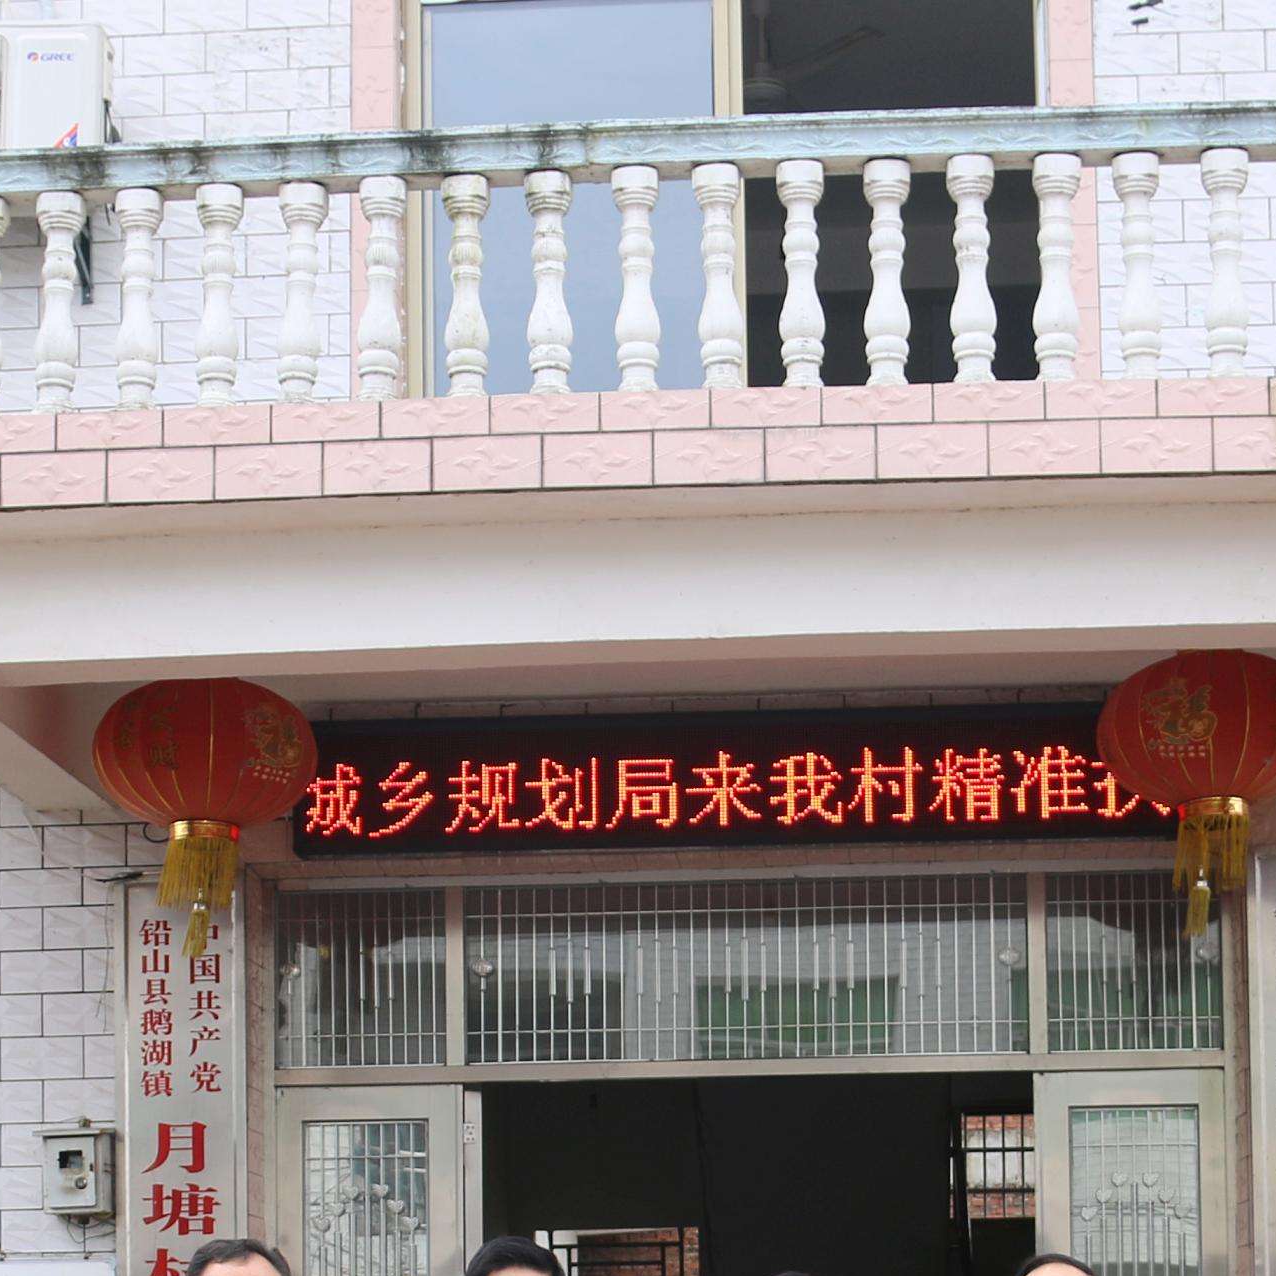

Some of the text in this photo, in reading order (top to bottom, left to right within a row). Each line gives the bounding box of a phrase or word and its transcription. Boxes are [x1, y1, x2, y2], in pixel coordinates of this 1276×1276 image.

[139, 919, 172, 1097] 铅山县鹅湖镇
